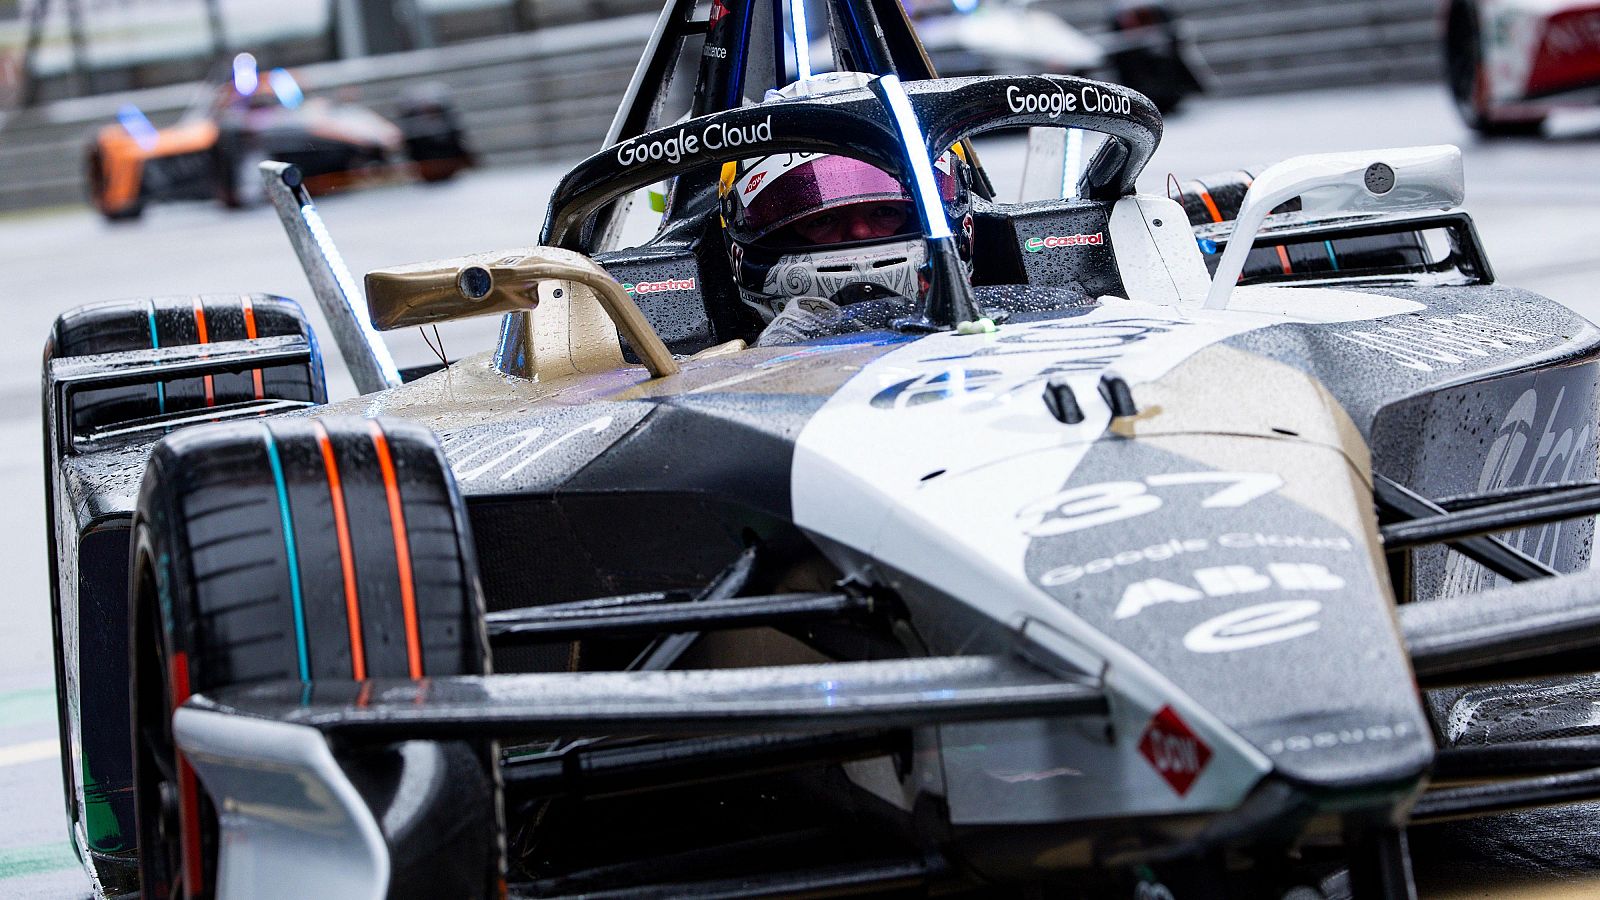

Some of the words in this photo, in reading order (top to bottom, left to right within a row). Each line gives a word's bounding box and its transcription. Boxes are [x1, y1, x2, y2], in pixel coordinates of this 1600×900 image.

[1006, 85, 1077, 118] Google
[1081, 86, 1131, 114] Cloud
[617, 128, 699, 165] Google
[703, 115, 772, 150] Cloud
[1044, 232, 1103, 248] Castrol
[635, 277, 696, 294] Castrol
[1014, 471, 1284, 537] 37
[1040, 539, 1207, 586] Google
[1113, 562, 1346, 620] ABB
